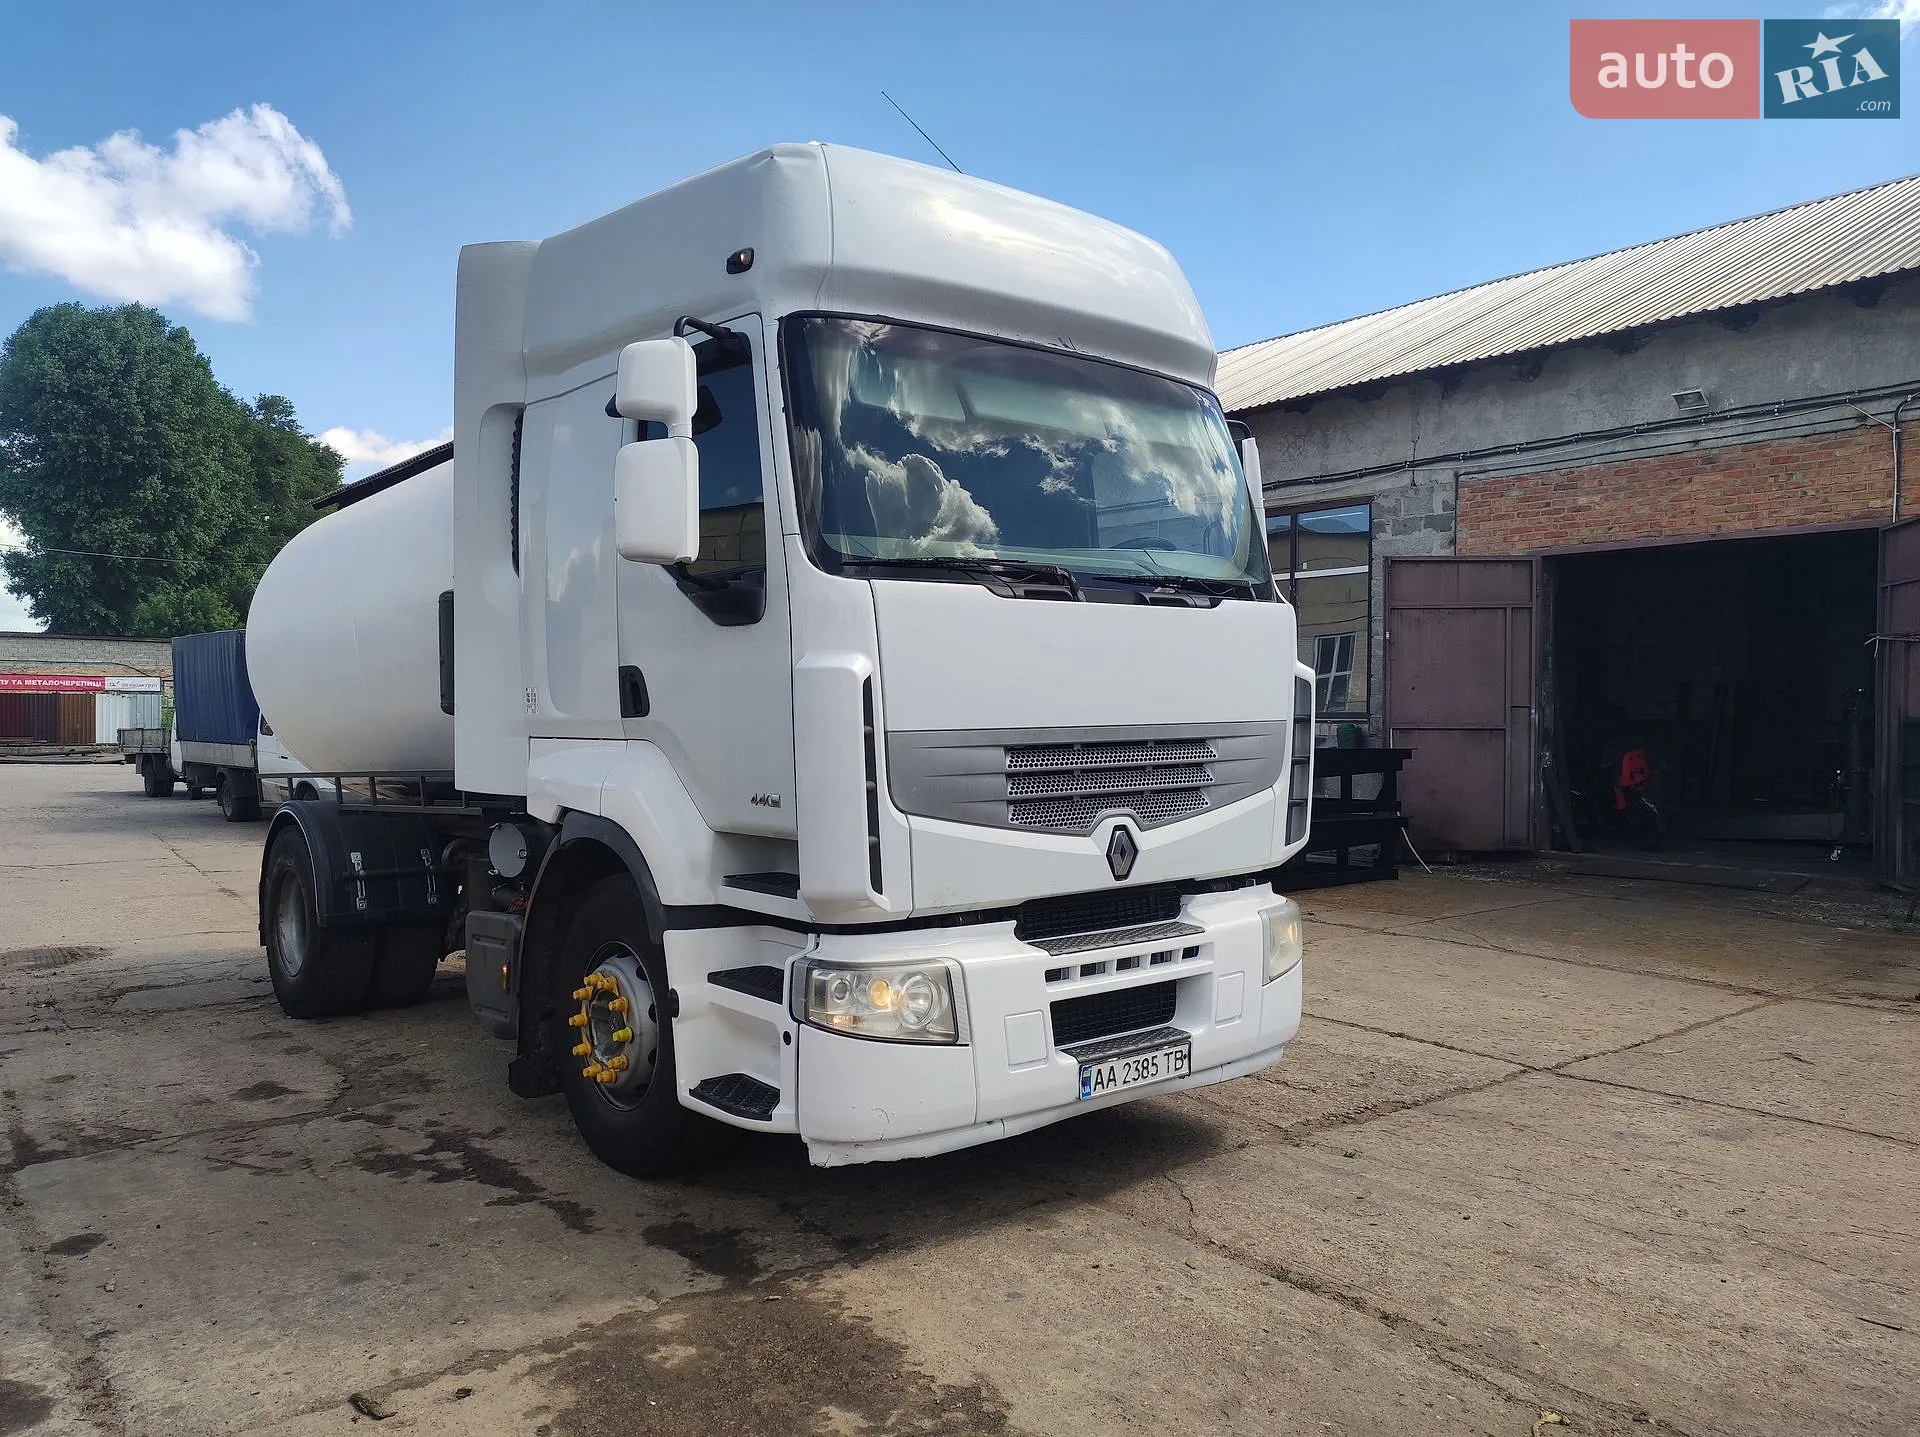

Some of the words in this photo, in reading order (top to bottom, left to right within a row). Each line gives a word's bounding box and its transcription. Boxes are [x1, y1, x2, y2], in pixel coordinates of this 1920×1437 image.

[1093, 1065, 1118, 1092] AA
[1122, 1055, 1159, 1085] 2385
[1163, 1049, 1184, 1074] TB
